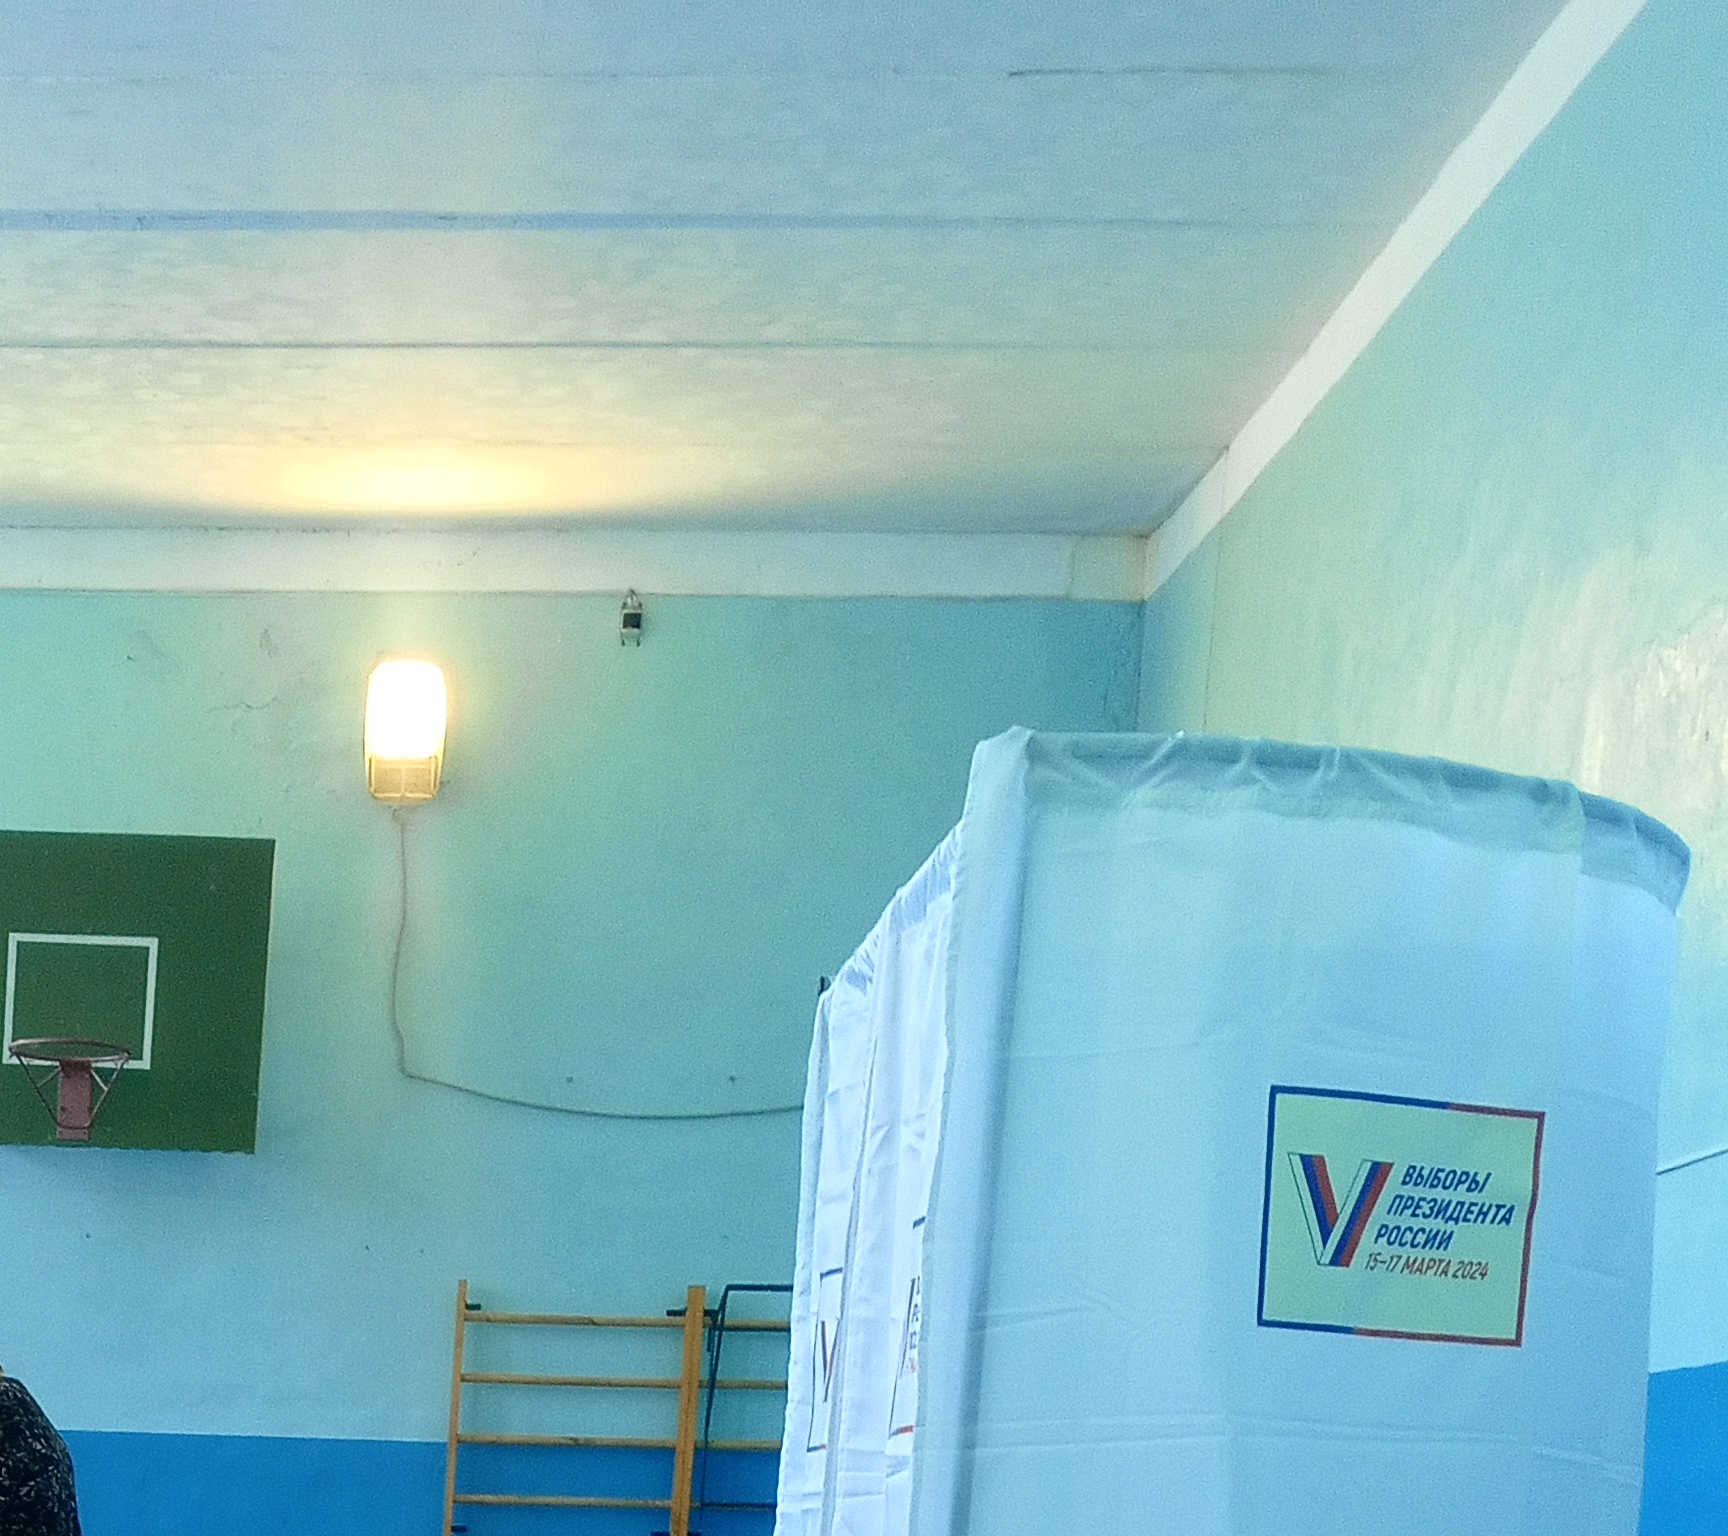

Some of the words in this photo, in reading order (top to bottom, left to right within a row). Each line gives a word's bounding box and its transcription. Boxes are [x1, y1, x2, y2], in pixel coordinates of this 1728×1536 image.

[1401, 1164, 1491, 1194] ВЫБОРЫ
[1386, 1194, 1516, 1226] ПРЕЗИДЕНТА
[1374, 1224, 1454, 1252] РОССИИ
[1401, 1255, 1452, 1278] МАРТА
[1452, 1260, 1490, 1281] 2024
